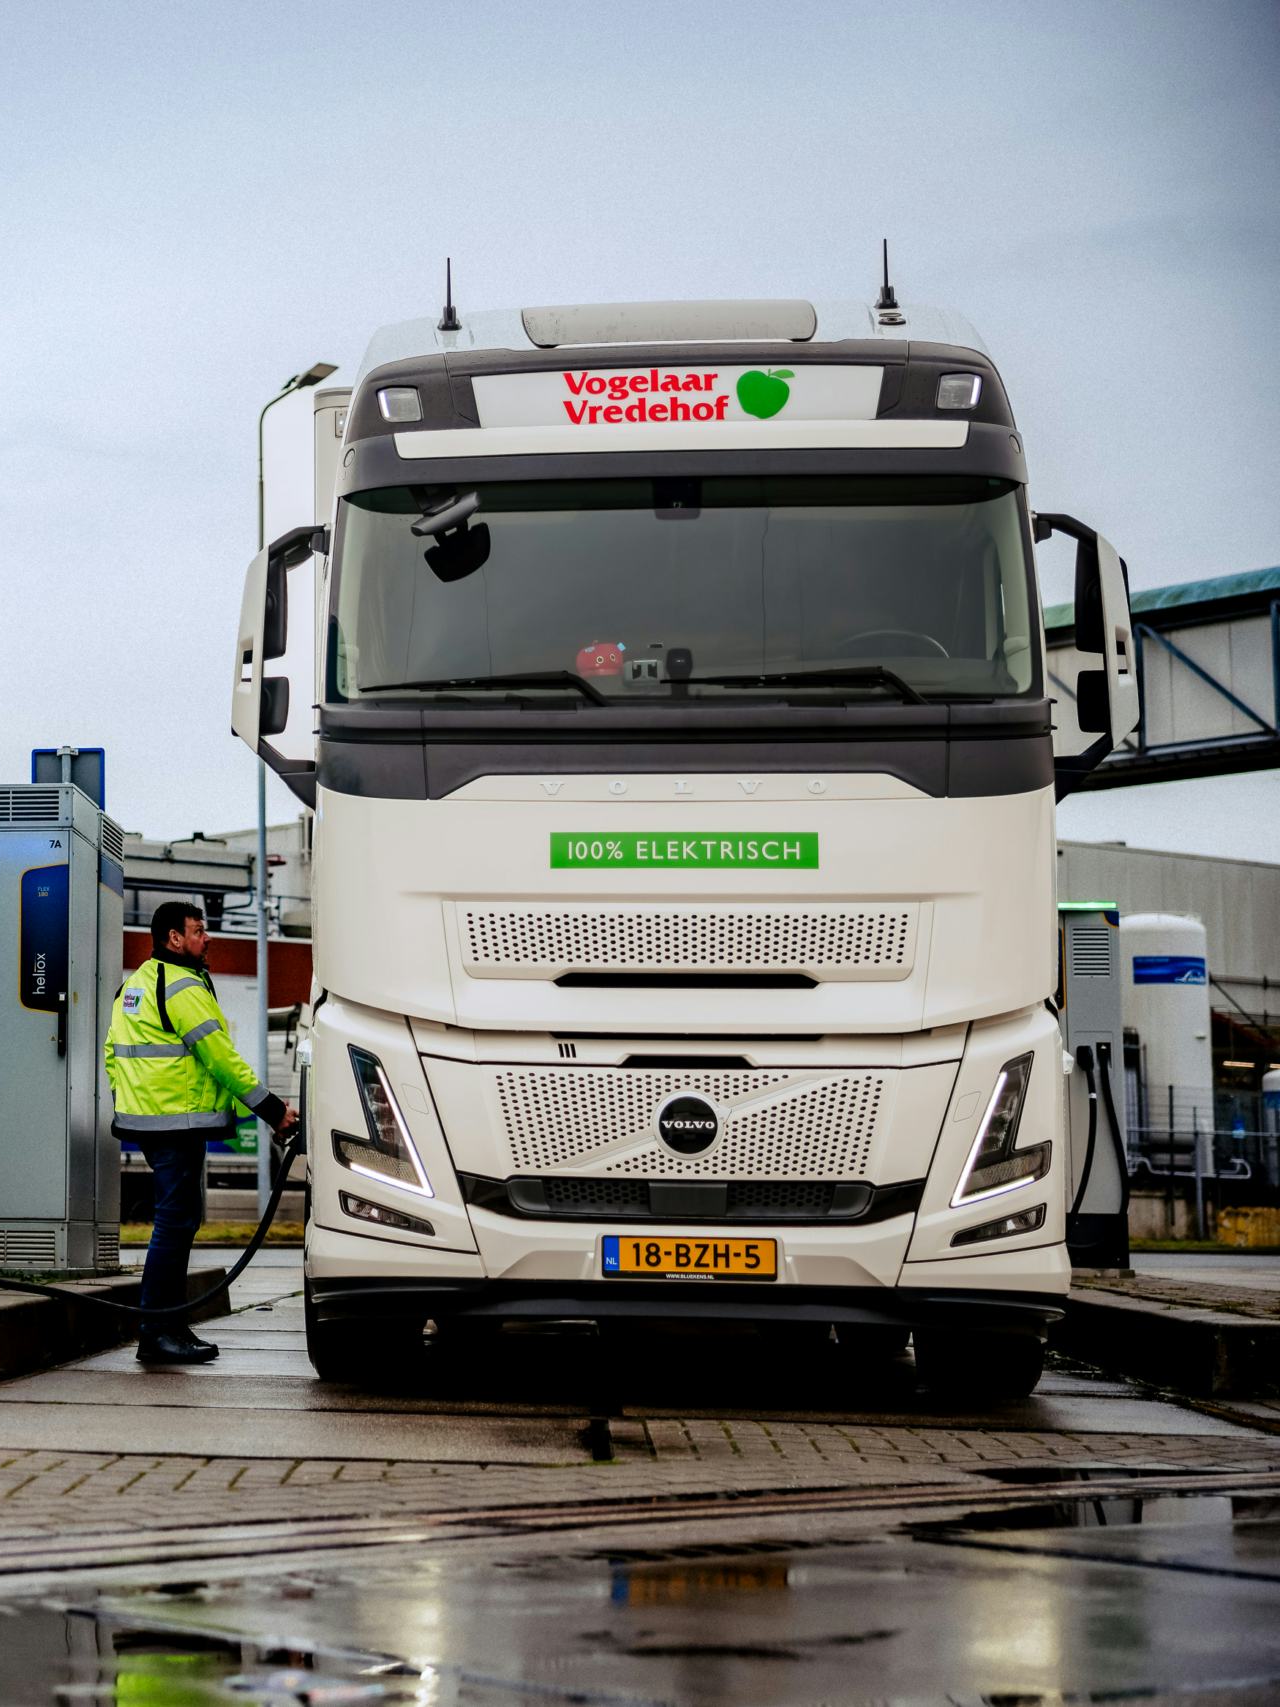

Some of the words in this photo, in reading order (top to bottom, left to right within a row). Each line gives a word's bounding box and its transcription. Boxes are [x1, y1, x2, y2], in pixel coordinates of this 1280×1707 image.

[562, 369, 719, 400] Vogelaar
[562, 395, 730, 425] Vredehof
[540, 779, 827, 796] VOLVO
[49, 839, 62, 849] 7A
[568, 840, 624, 860] 100%
[636, 840, 801, 861] ELEKTRISCH
[32, 952, 46, 995] heliox
[661, 1120, 715, 1129] VOLVO
[605, 1257, 617, 1265] NL
[632, 1242, 761, 1269] 18-BZH-5
